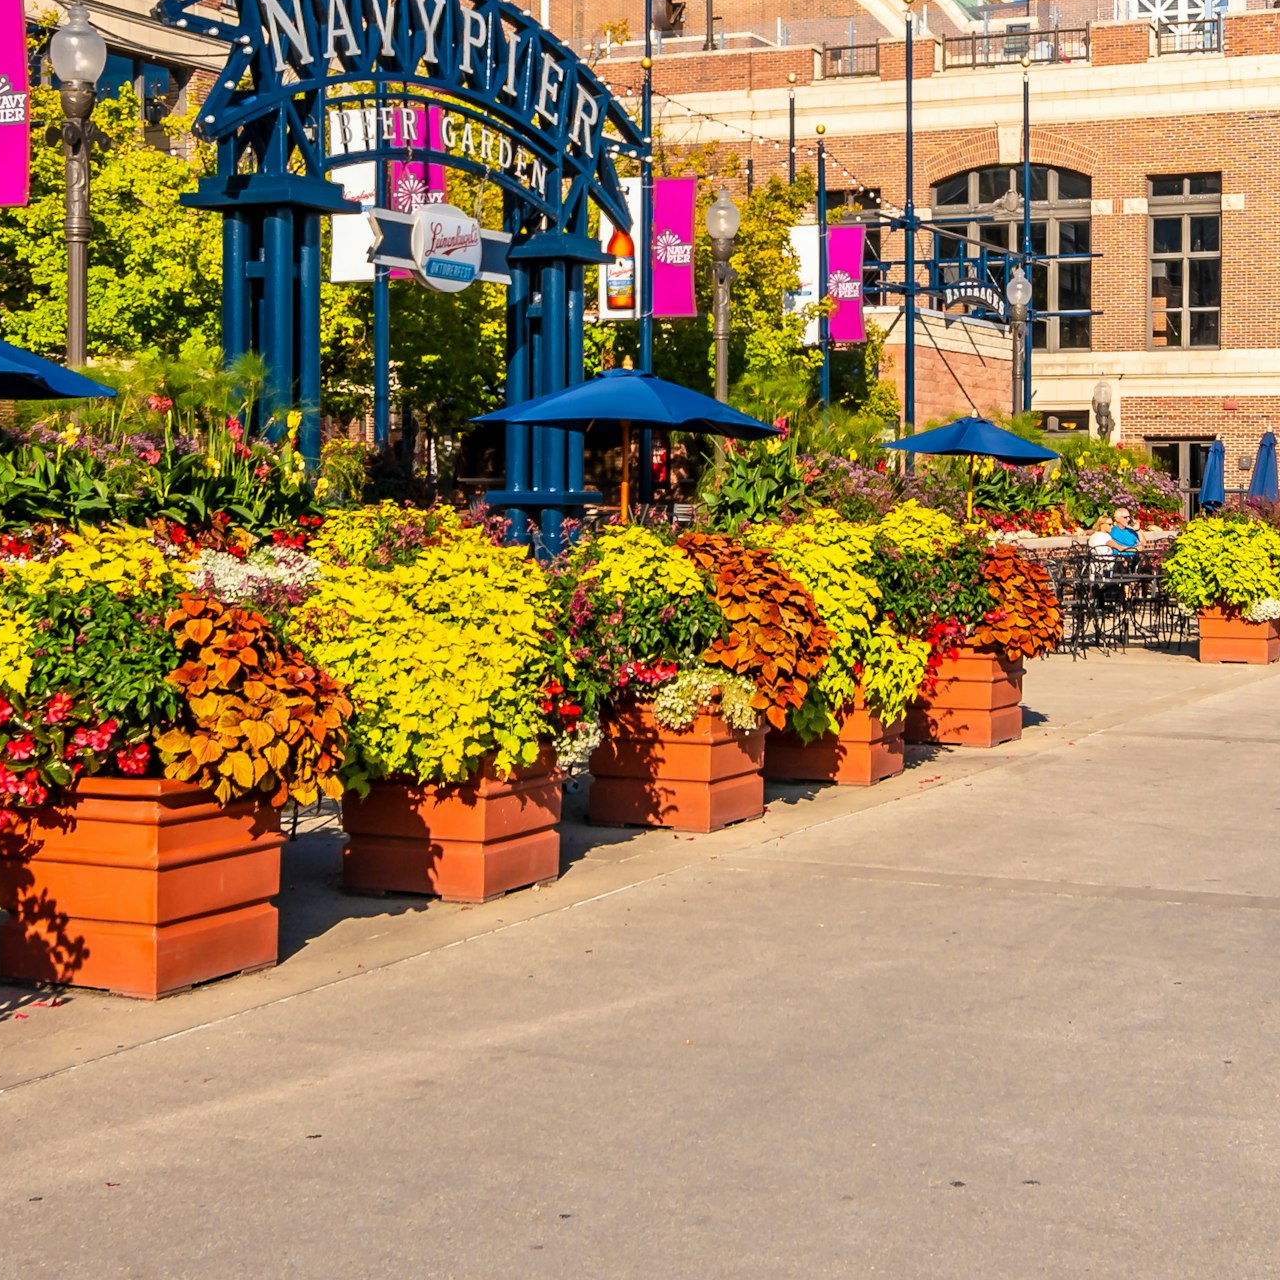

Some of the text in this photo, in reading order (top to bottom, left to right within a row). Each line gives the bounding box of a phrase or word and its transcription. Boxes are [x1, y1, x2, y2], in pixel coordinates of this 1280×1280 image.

[336, 107, 548, 195] BEER GARDEN
[411, 192, 445, 205] NAVY
[667, 245, 692, 255] NAVY
[667, 254, 691, 264] PIER
[429, 261, 472, 279] OKTOBERFEST
[838, 282, 861, 291] NAVY
[838, 289, 860, 298] PIER
